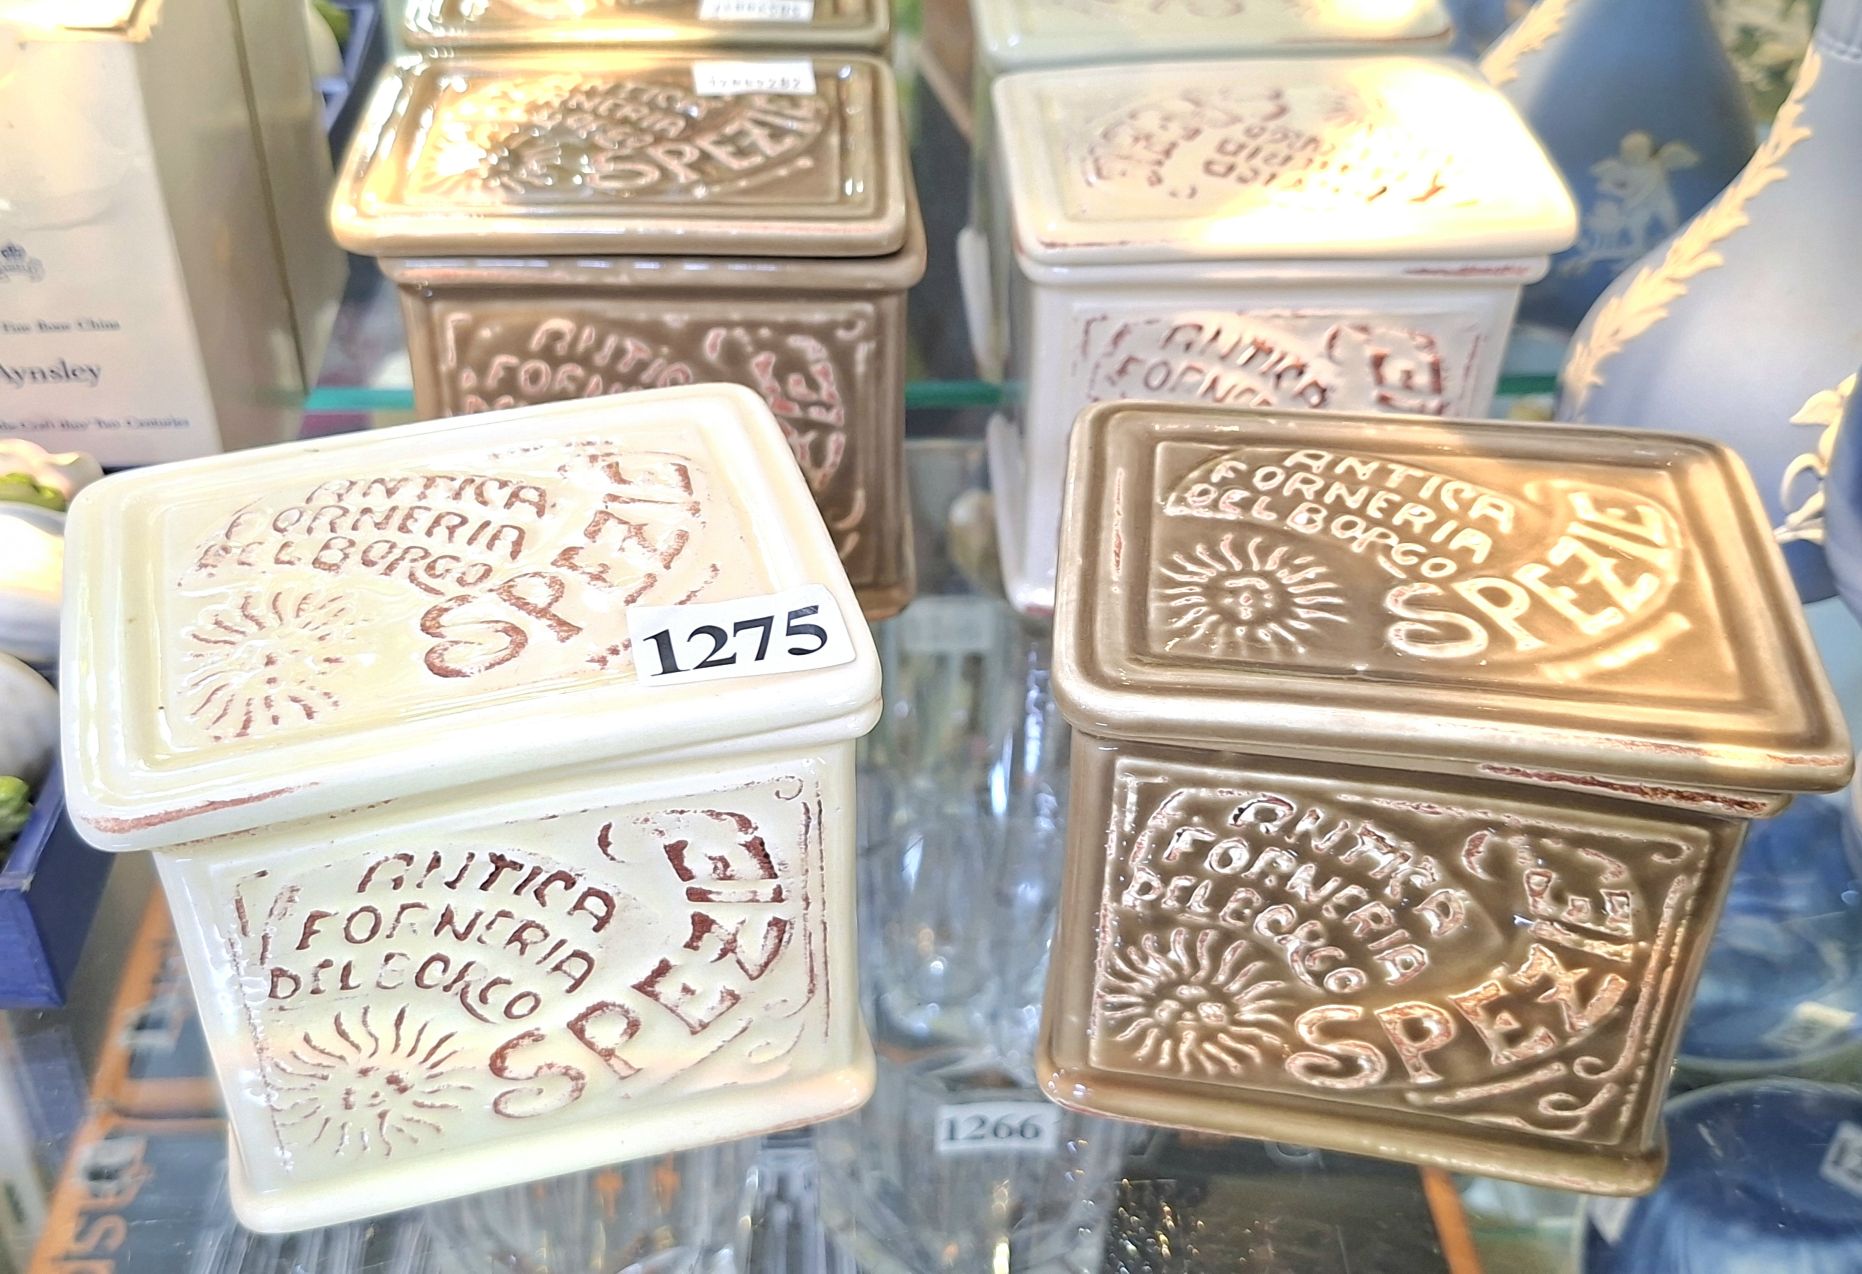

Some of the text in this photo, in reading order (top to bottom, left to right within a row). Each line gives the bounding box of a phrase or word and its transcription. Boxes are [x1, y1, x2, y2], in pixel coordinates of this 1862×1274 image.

[531, 318, 694, 389] ANTIC
[1108, 354, 1284, 408] FORNE
[225, 504, 526, 561] FORNERIA
[305, 474, 547, 519] ANTICA
[1186, 483, 1458, 579] DEL BORGO
[1211, 460, 1494, 565] FORNERIA
[1283, 449, 1516, 534] ANTICA
[1384, 491, 1679, 659] SPEZIE
[643, 605, 828, 677] 1275
[357, 850, 617, 933] ANTICA
[296, 901, 596, 994] FORNERIA
[489, 836, 791, 1119] SPEZIE
[1285, 867, 1634, 1090] SPEZIE
[942, 1113, 1042, 1141] 1266
